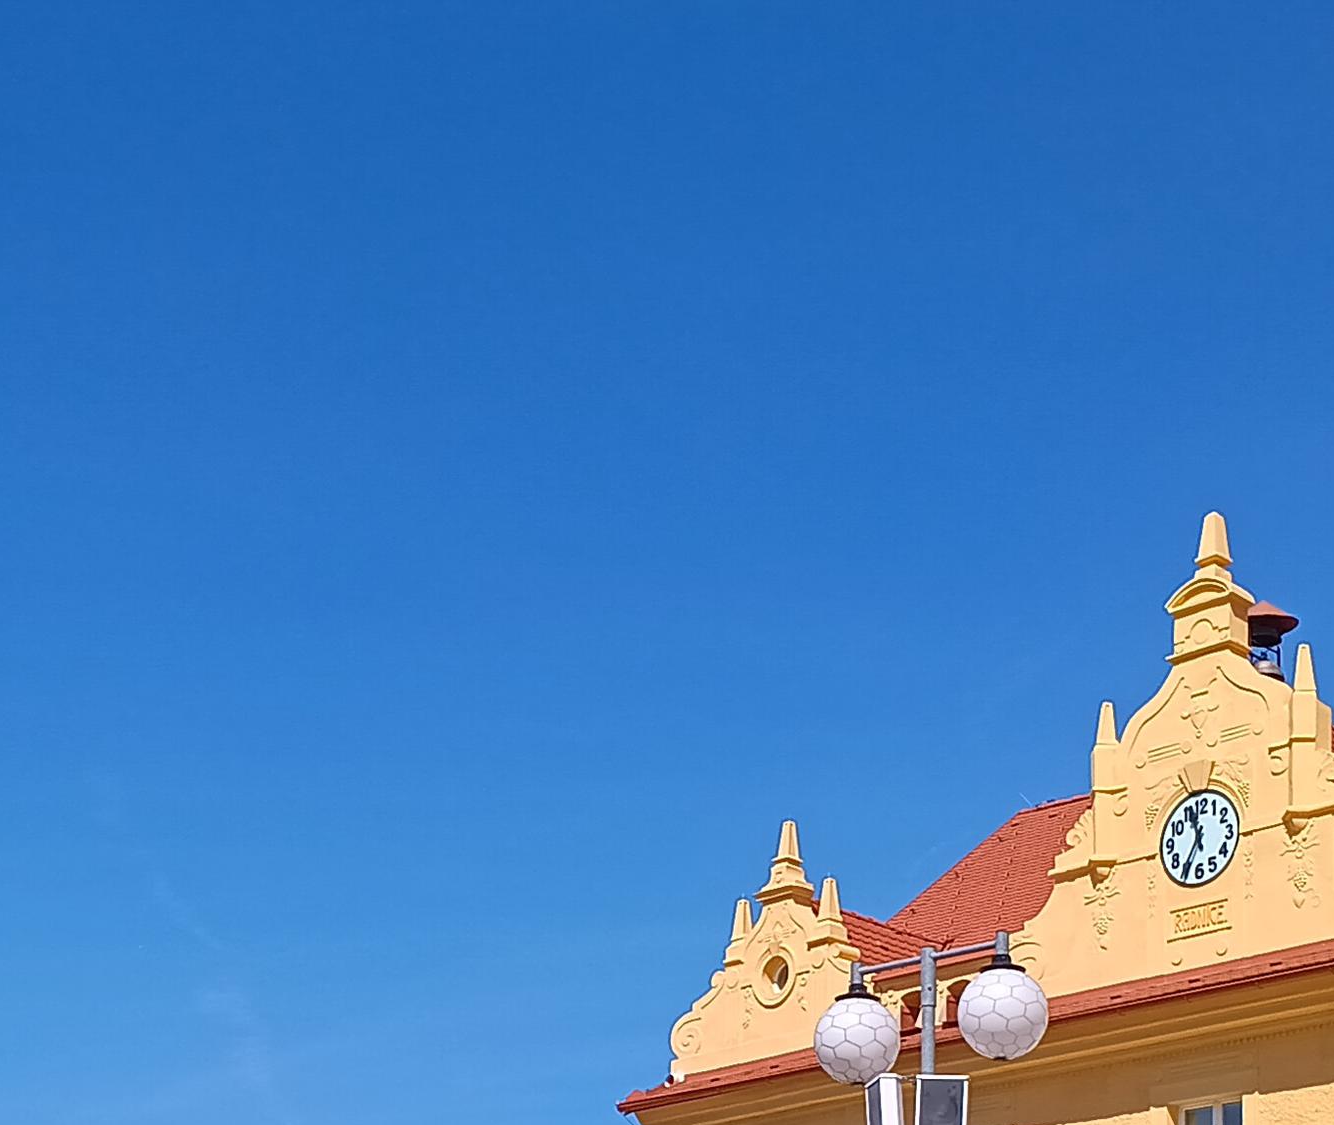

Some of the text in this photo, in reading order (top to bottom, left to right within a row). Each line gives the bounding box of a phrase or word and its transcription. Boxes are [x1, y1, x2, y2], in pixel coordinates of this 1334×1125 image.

[1195, 797, 1208, 818] 12
[1211, 799, 1217, 816] 1
[1219, 806, 1228, 824] 2
[1171, 820, 1184, 837] 10
[1225, 823, 1234, 840] 3
[1166, 838, 1175, 855] 9
[1219, 841, 1228, 858] 4
[1171, 852, 1180, 870] 8
[1208, 856, 1217, 873] 5
[1194, 862, 1205, 880] 6
